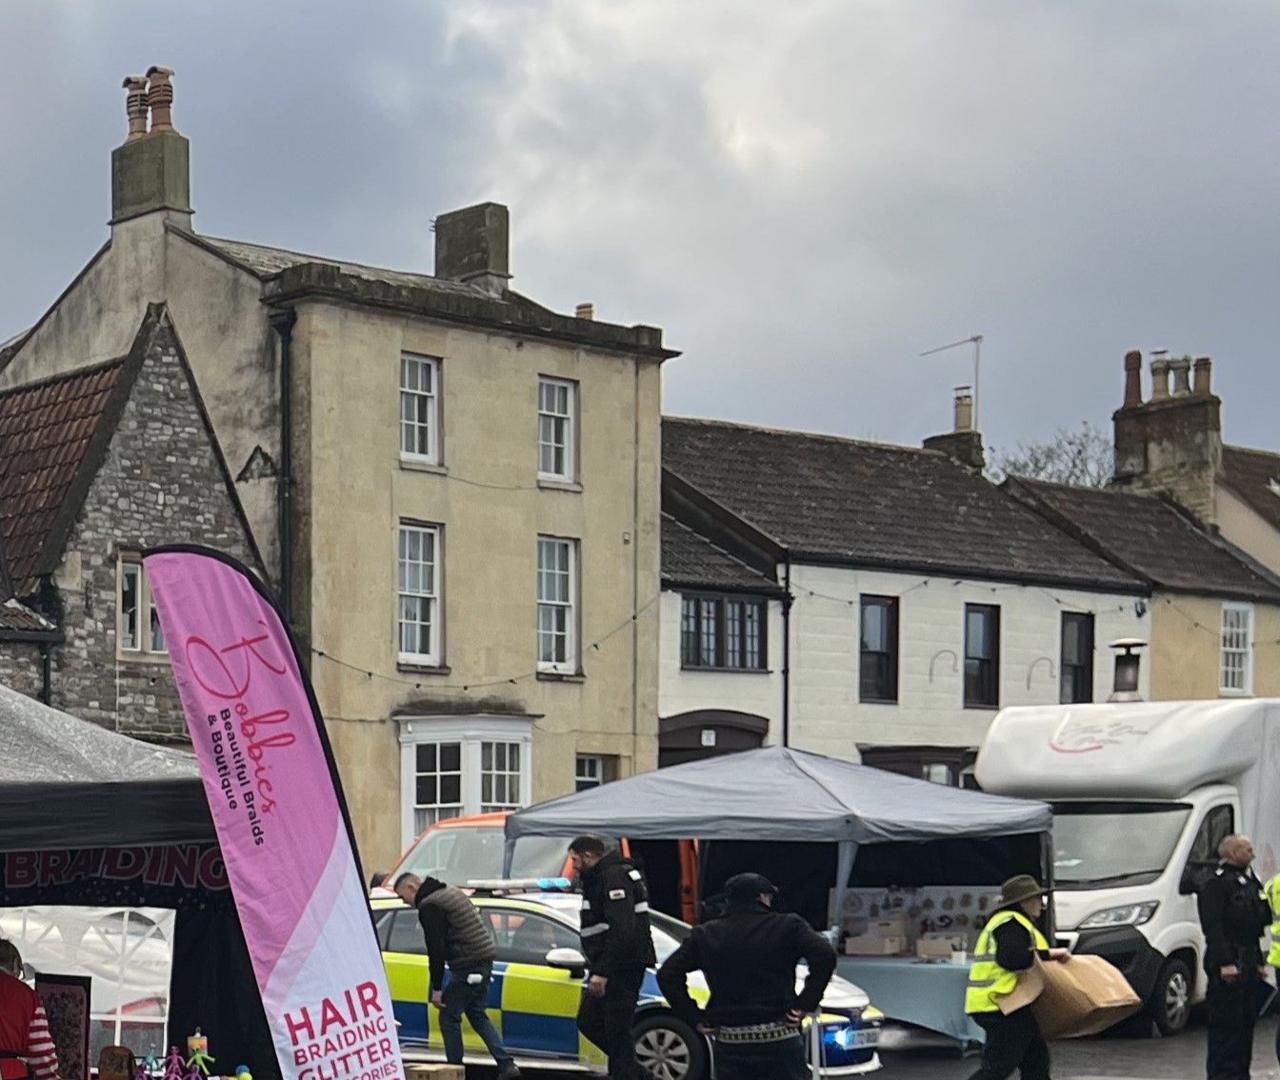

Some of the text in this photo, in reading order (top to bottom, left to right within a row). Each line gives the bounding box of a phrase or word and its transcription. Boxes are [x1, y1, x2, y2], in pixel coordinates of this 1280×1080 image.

[185, 618, 296, 814] Bobbies
[207, 714, 238, 810] & Boutique
[220, 707, 265, 846] Beautiful Braids
[283, 981, 383, 1046] HAIR
[294, 1015, 388, 1067] BRAIDING
